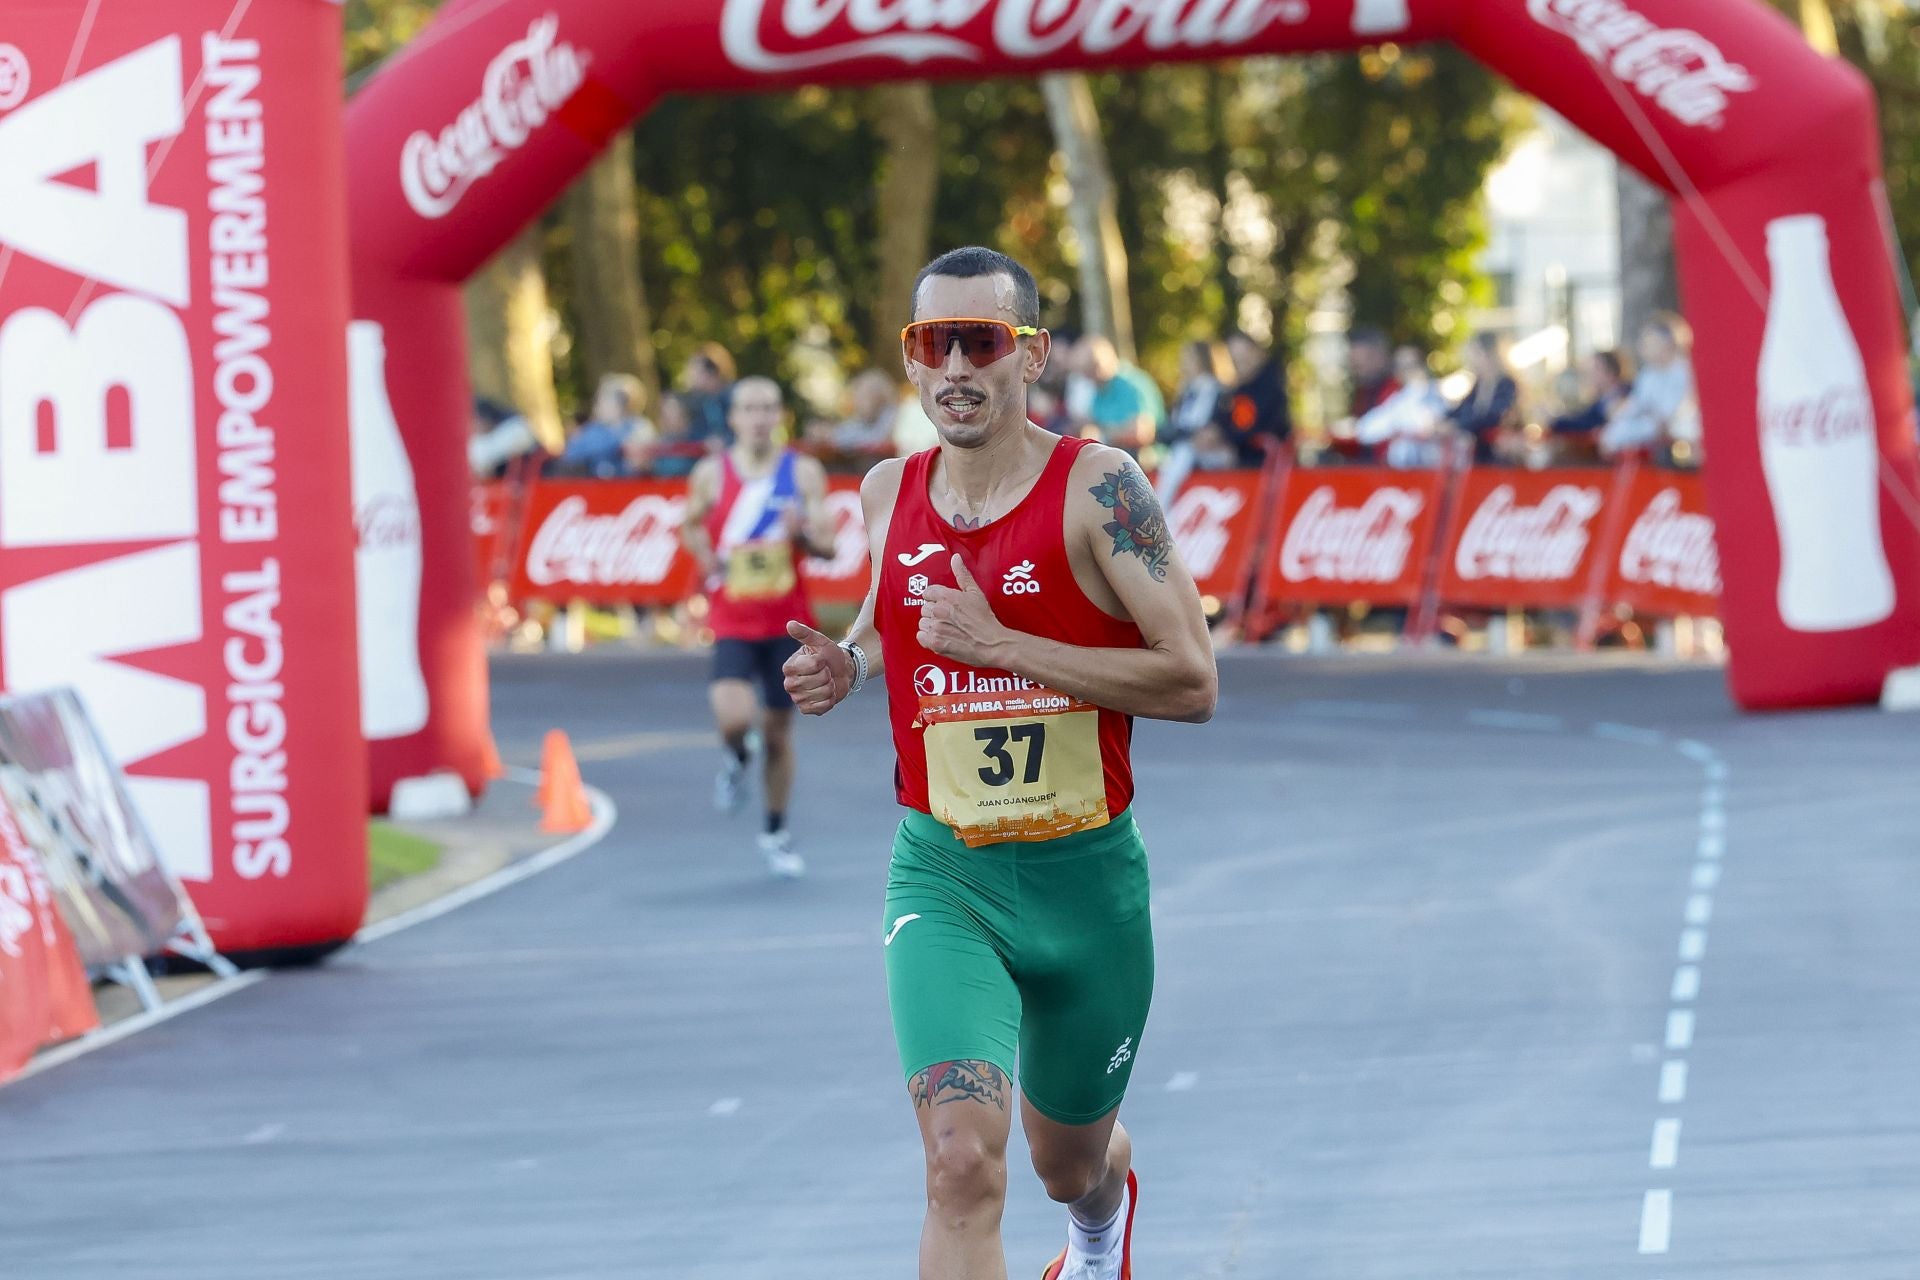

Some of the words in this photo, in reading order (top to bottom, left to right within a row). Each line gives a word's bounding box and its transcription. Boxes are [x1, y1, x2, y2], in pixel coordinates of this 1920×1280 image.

[202, 31, 277, 543] EMPOWERMENT
[0, 33, 212, 882] MBA
[949, 671, 1045, 694] Llamie
[969, 700, 1004, 713] MBA
[1005, 703, 1032, 711] maratón
[1032, 695, 1070, 709] GIJÓN
[222, 558, 292, 880] SURGICAL
[974, 723, 1046, 787] 37
[976, 799, 1002, 807] JUAN
[1003, 792, 1057, 806] OJANGUREN
